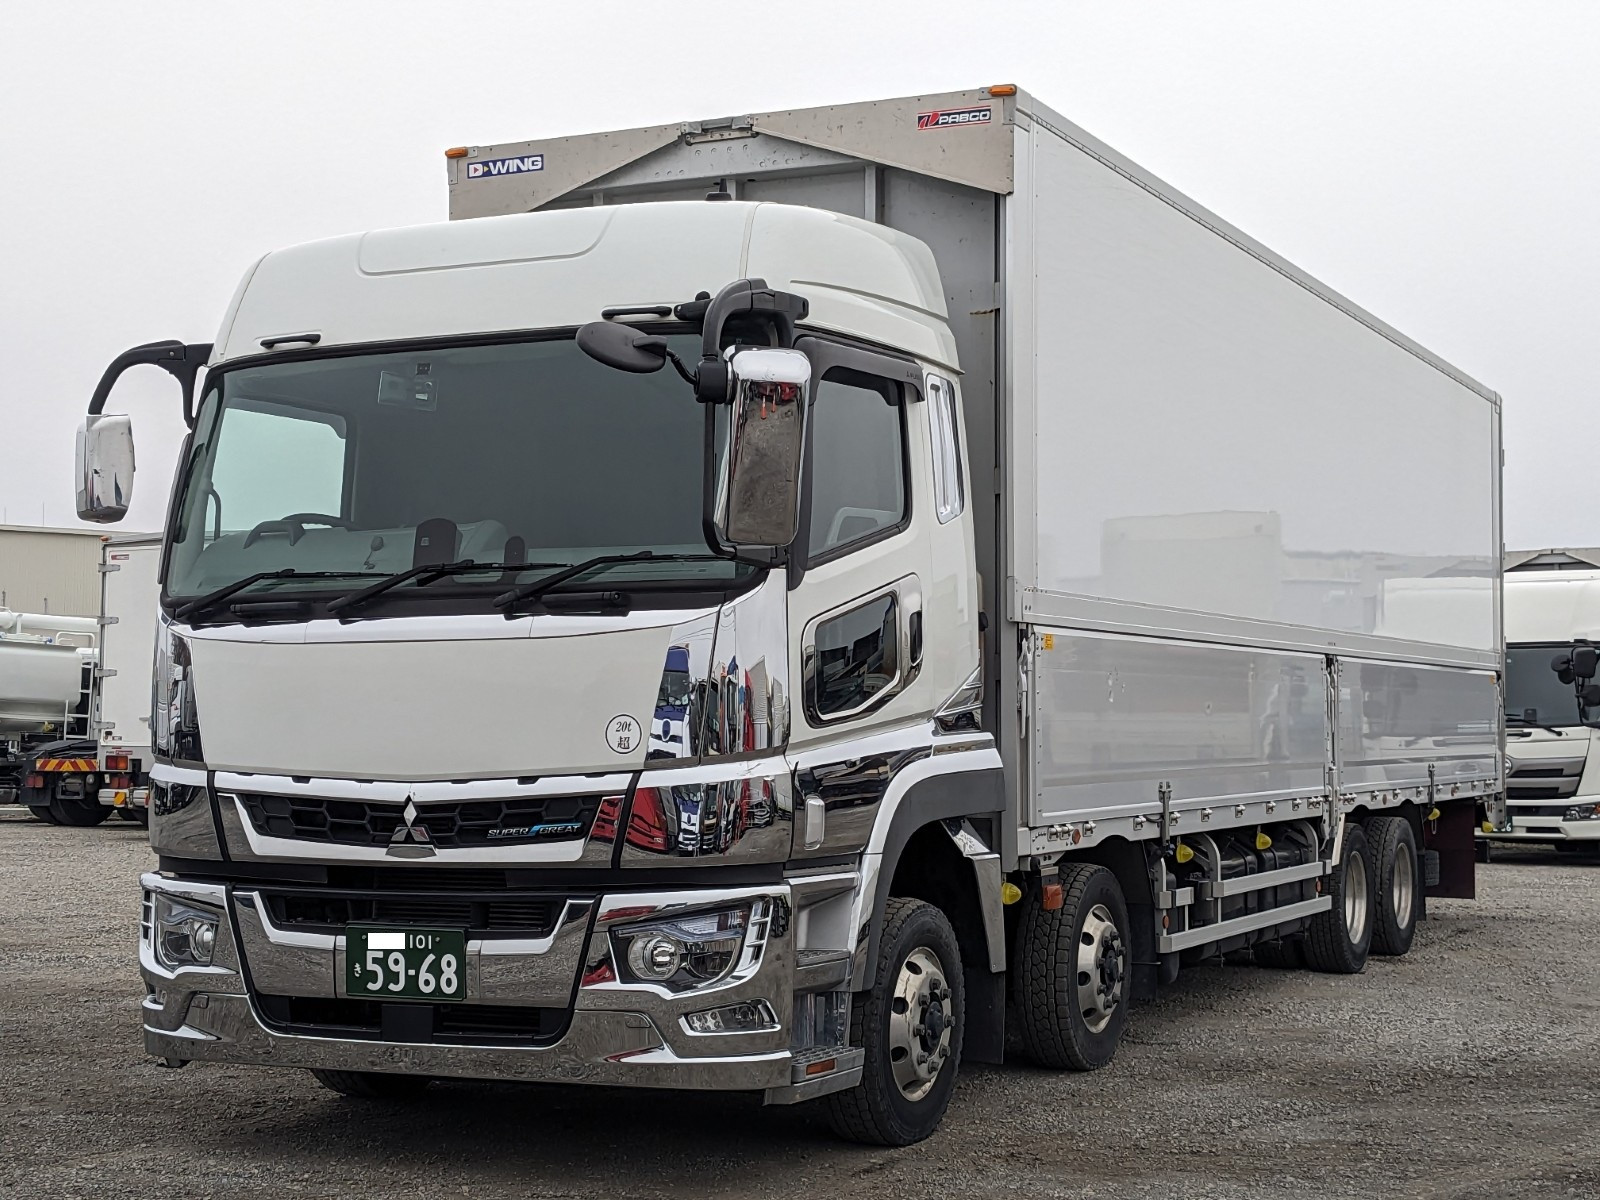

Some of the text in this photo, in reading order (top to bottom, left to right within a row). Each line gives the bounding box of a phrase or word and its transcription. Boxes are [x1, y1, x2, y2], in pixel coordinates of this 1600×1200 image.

[938, 111, 990, 124] PABCO
[616, 721, 632, 732] 20t
[488, 825, 579, 837] SUPER GREAT
[409, 934, 432, 949] 101
[366, 950, 458, 994] 59-68
